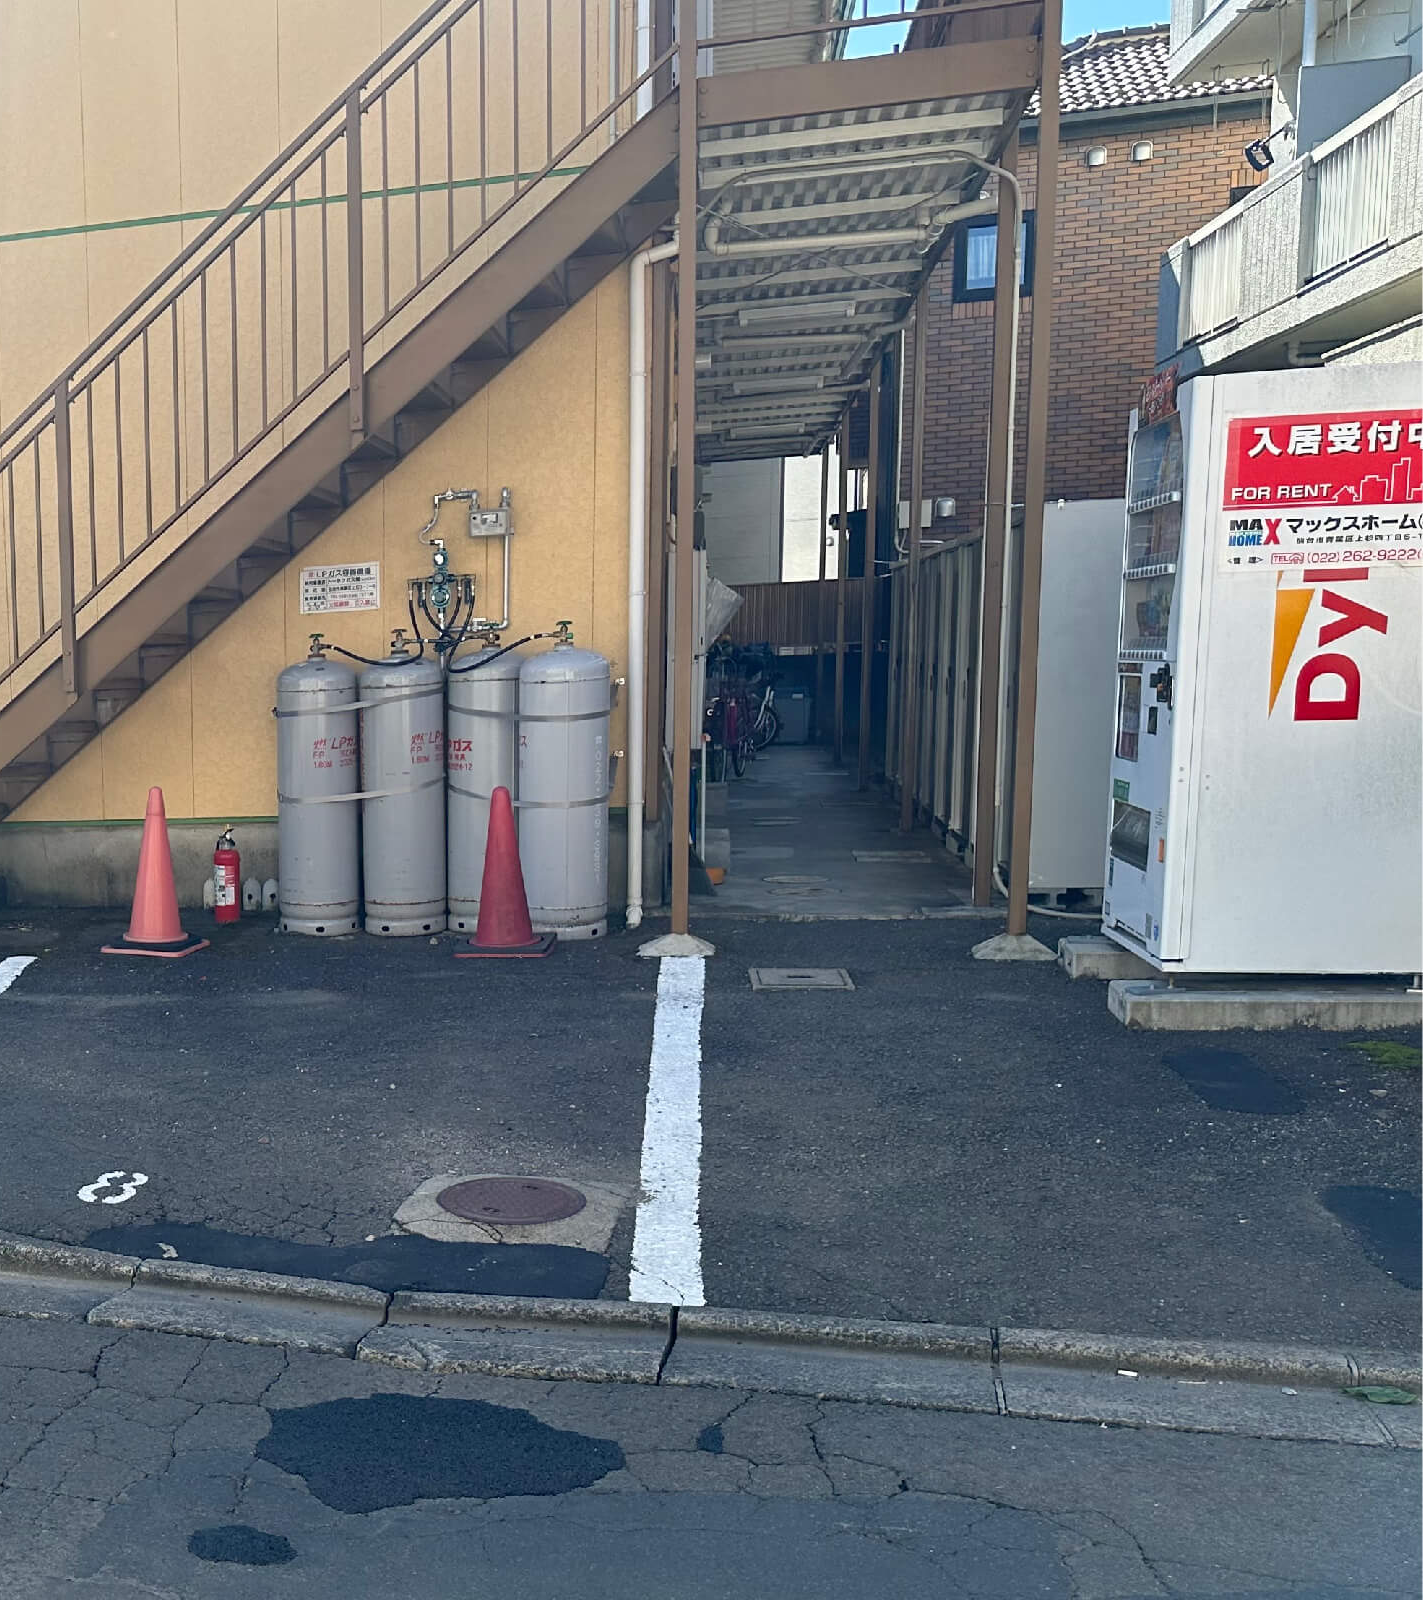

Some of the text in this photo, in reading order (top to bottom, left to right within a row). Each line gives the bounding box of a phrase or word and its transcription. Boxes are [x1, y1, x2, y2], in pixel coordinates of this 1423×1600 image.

[1231, 483, 1332, 500] FOR RENT
[1228, 534, 1263, 547] HOME
[1229, 518, 1282, 545] MAX
[77, 1170, 149, 1204] 8
